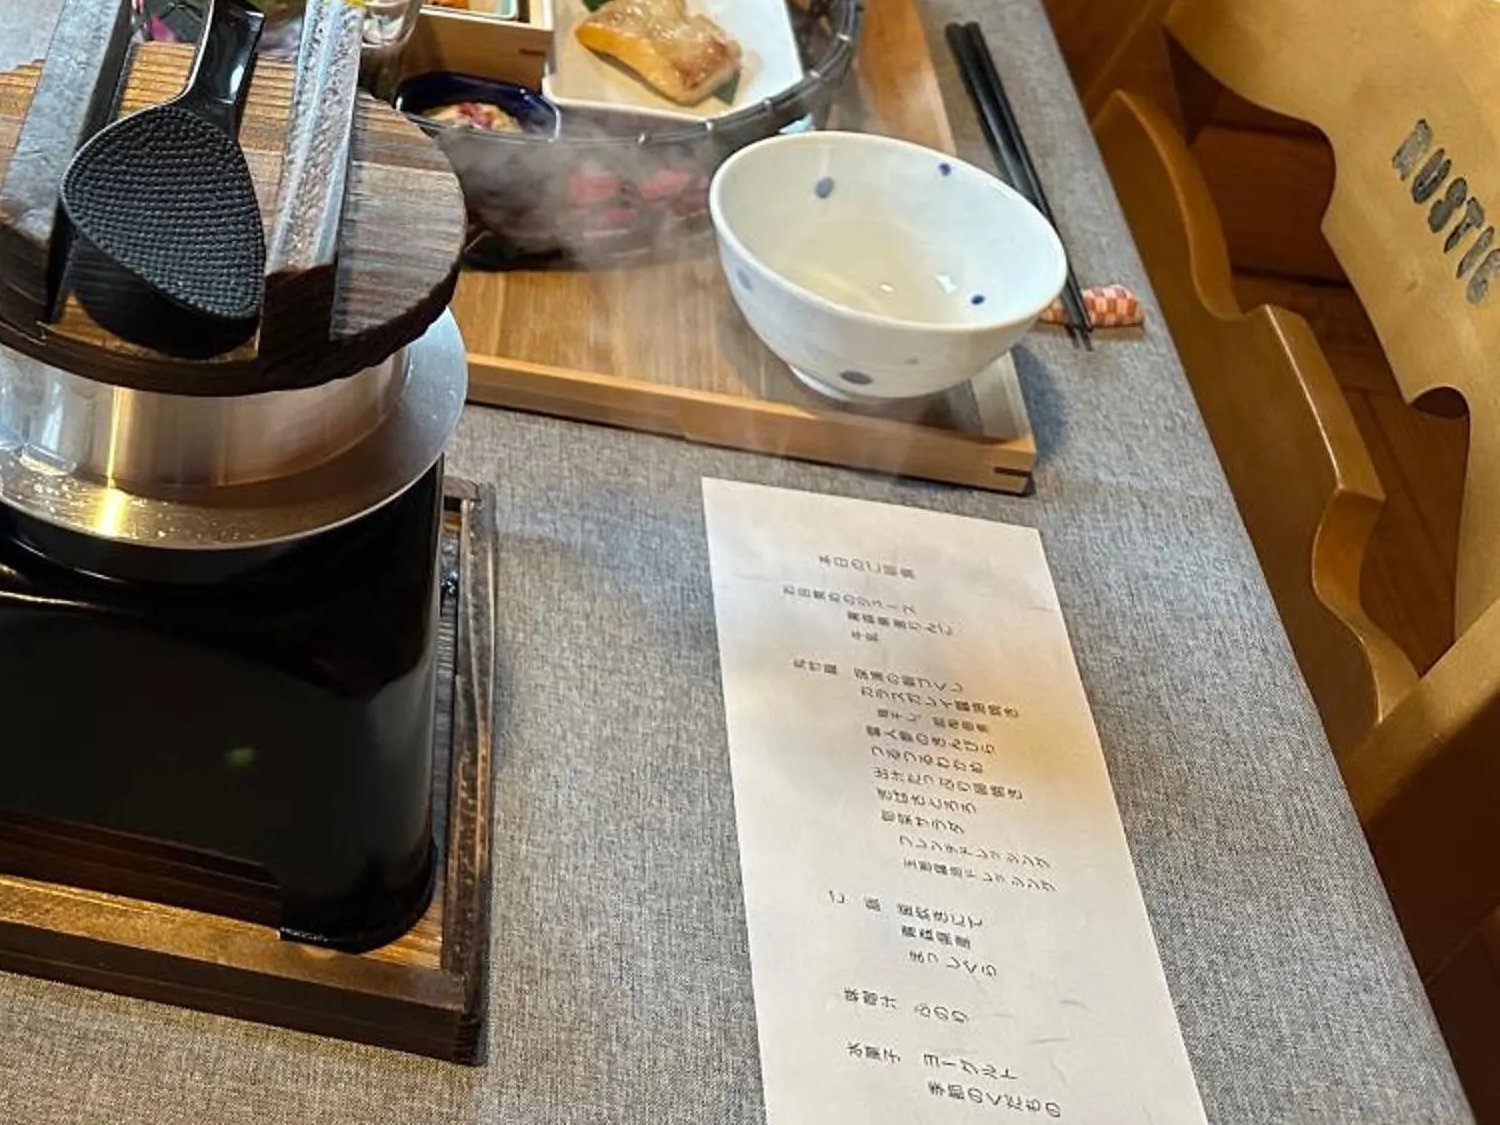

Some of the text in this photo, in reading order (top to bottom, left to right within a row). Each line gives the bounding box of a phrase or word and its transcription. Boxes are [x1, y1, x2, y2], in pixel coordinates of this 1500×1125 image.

[924, 1054, 1017, 1079] ヨーグルト
